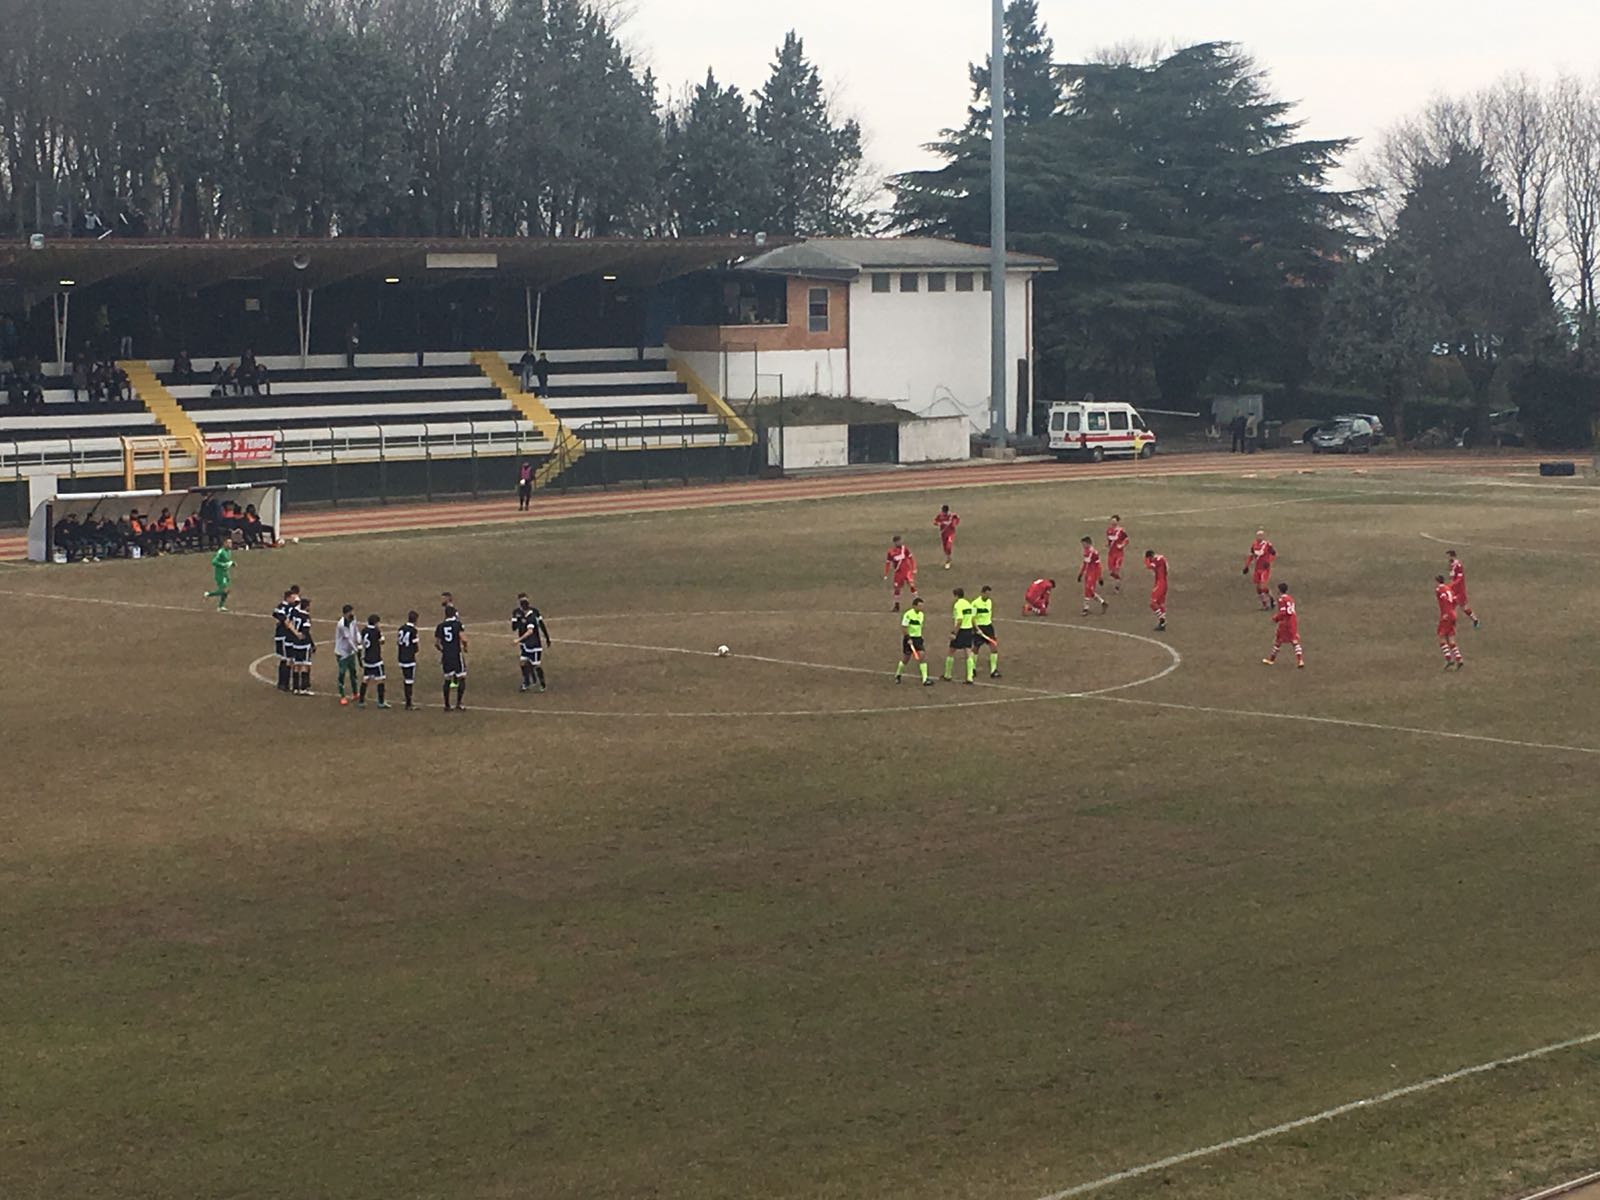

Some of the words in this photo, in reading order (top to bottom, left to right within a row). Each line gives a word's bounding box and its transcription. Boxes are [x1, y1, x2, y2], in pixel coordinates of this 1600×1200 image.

[363, 633, 371, 649] 6
[398, 629, 411, 647] 24
[443, 626, 454, 642] 5
